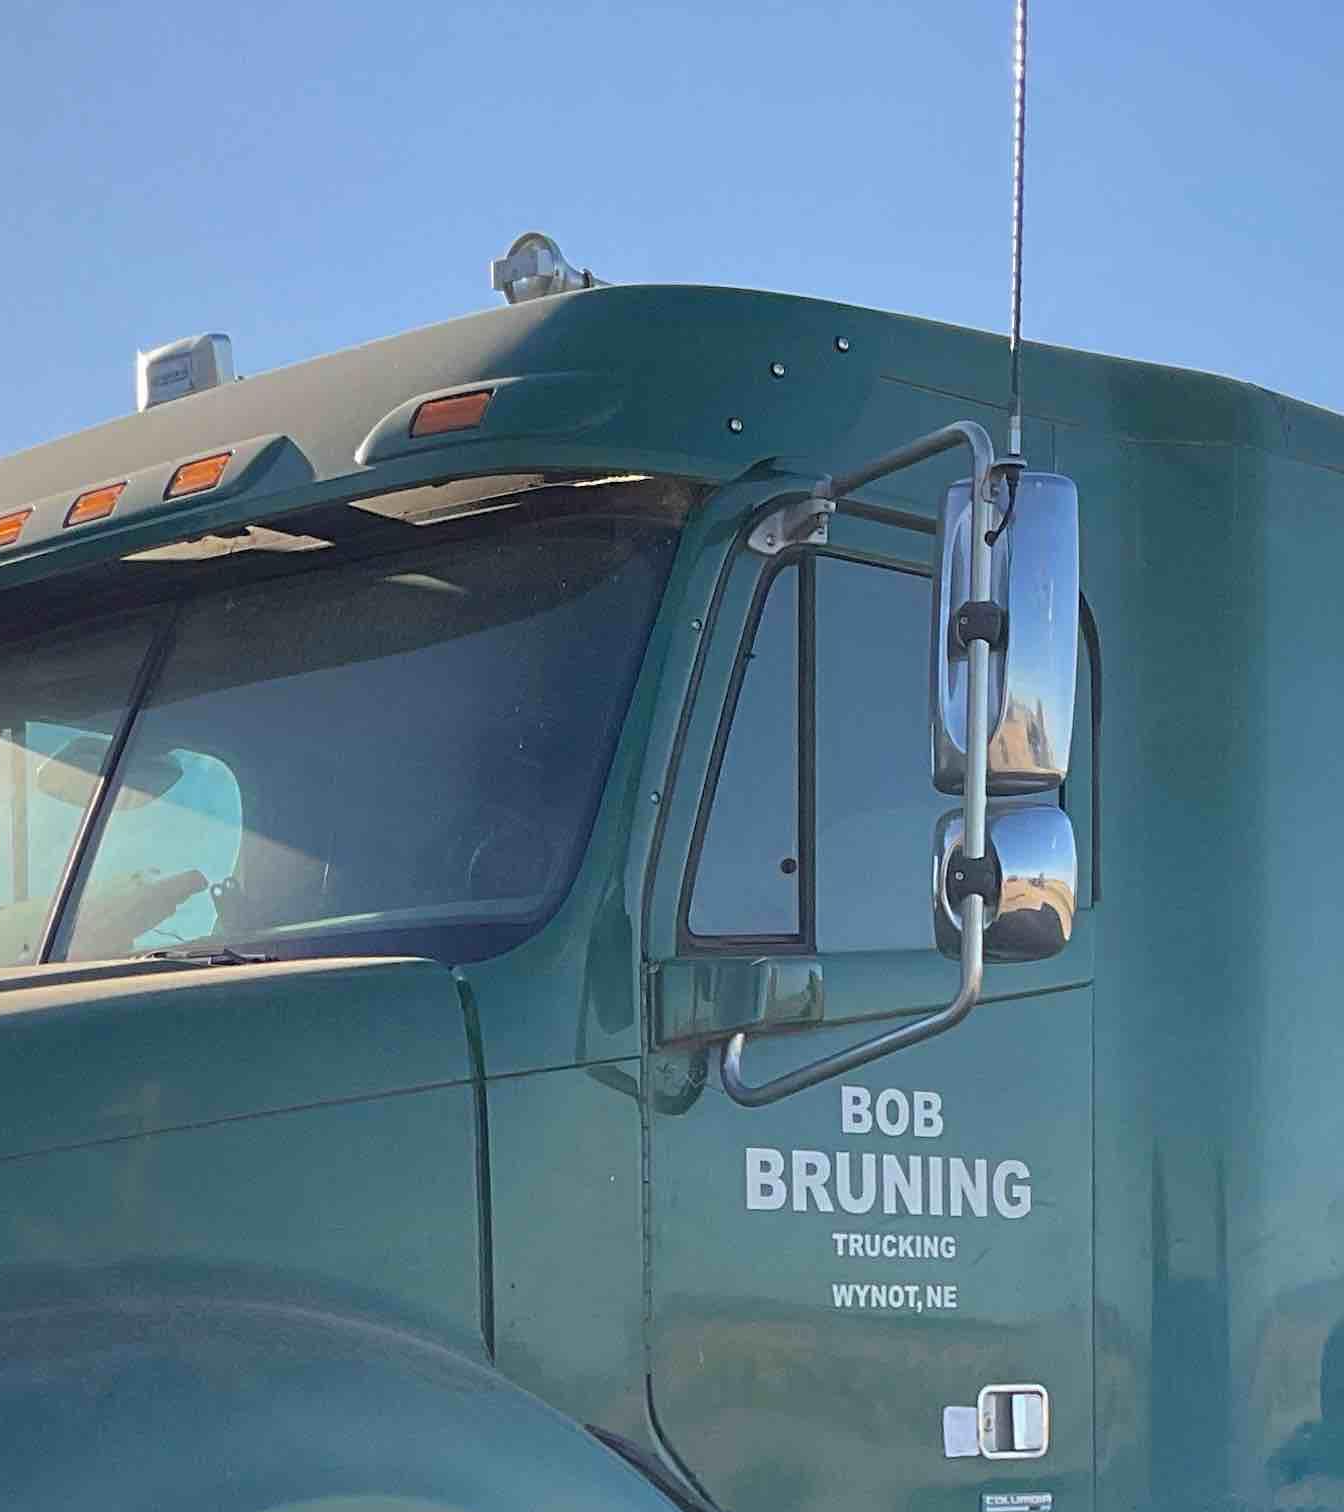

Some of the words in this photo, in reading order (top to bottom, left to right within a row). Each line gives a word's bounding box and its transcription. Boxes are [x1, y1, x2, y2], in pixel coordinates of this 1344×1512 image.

[841, 1085, 944, 1137] BOB
[745, 1147, 1032, 1219] BRUNING
[832, 1232, 957, 1259] TRUCKING
